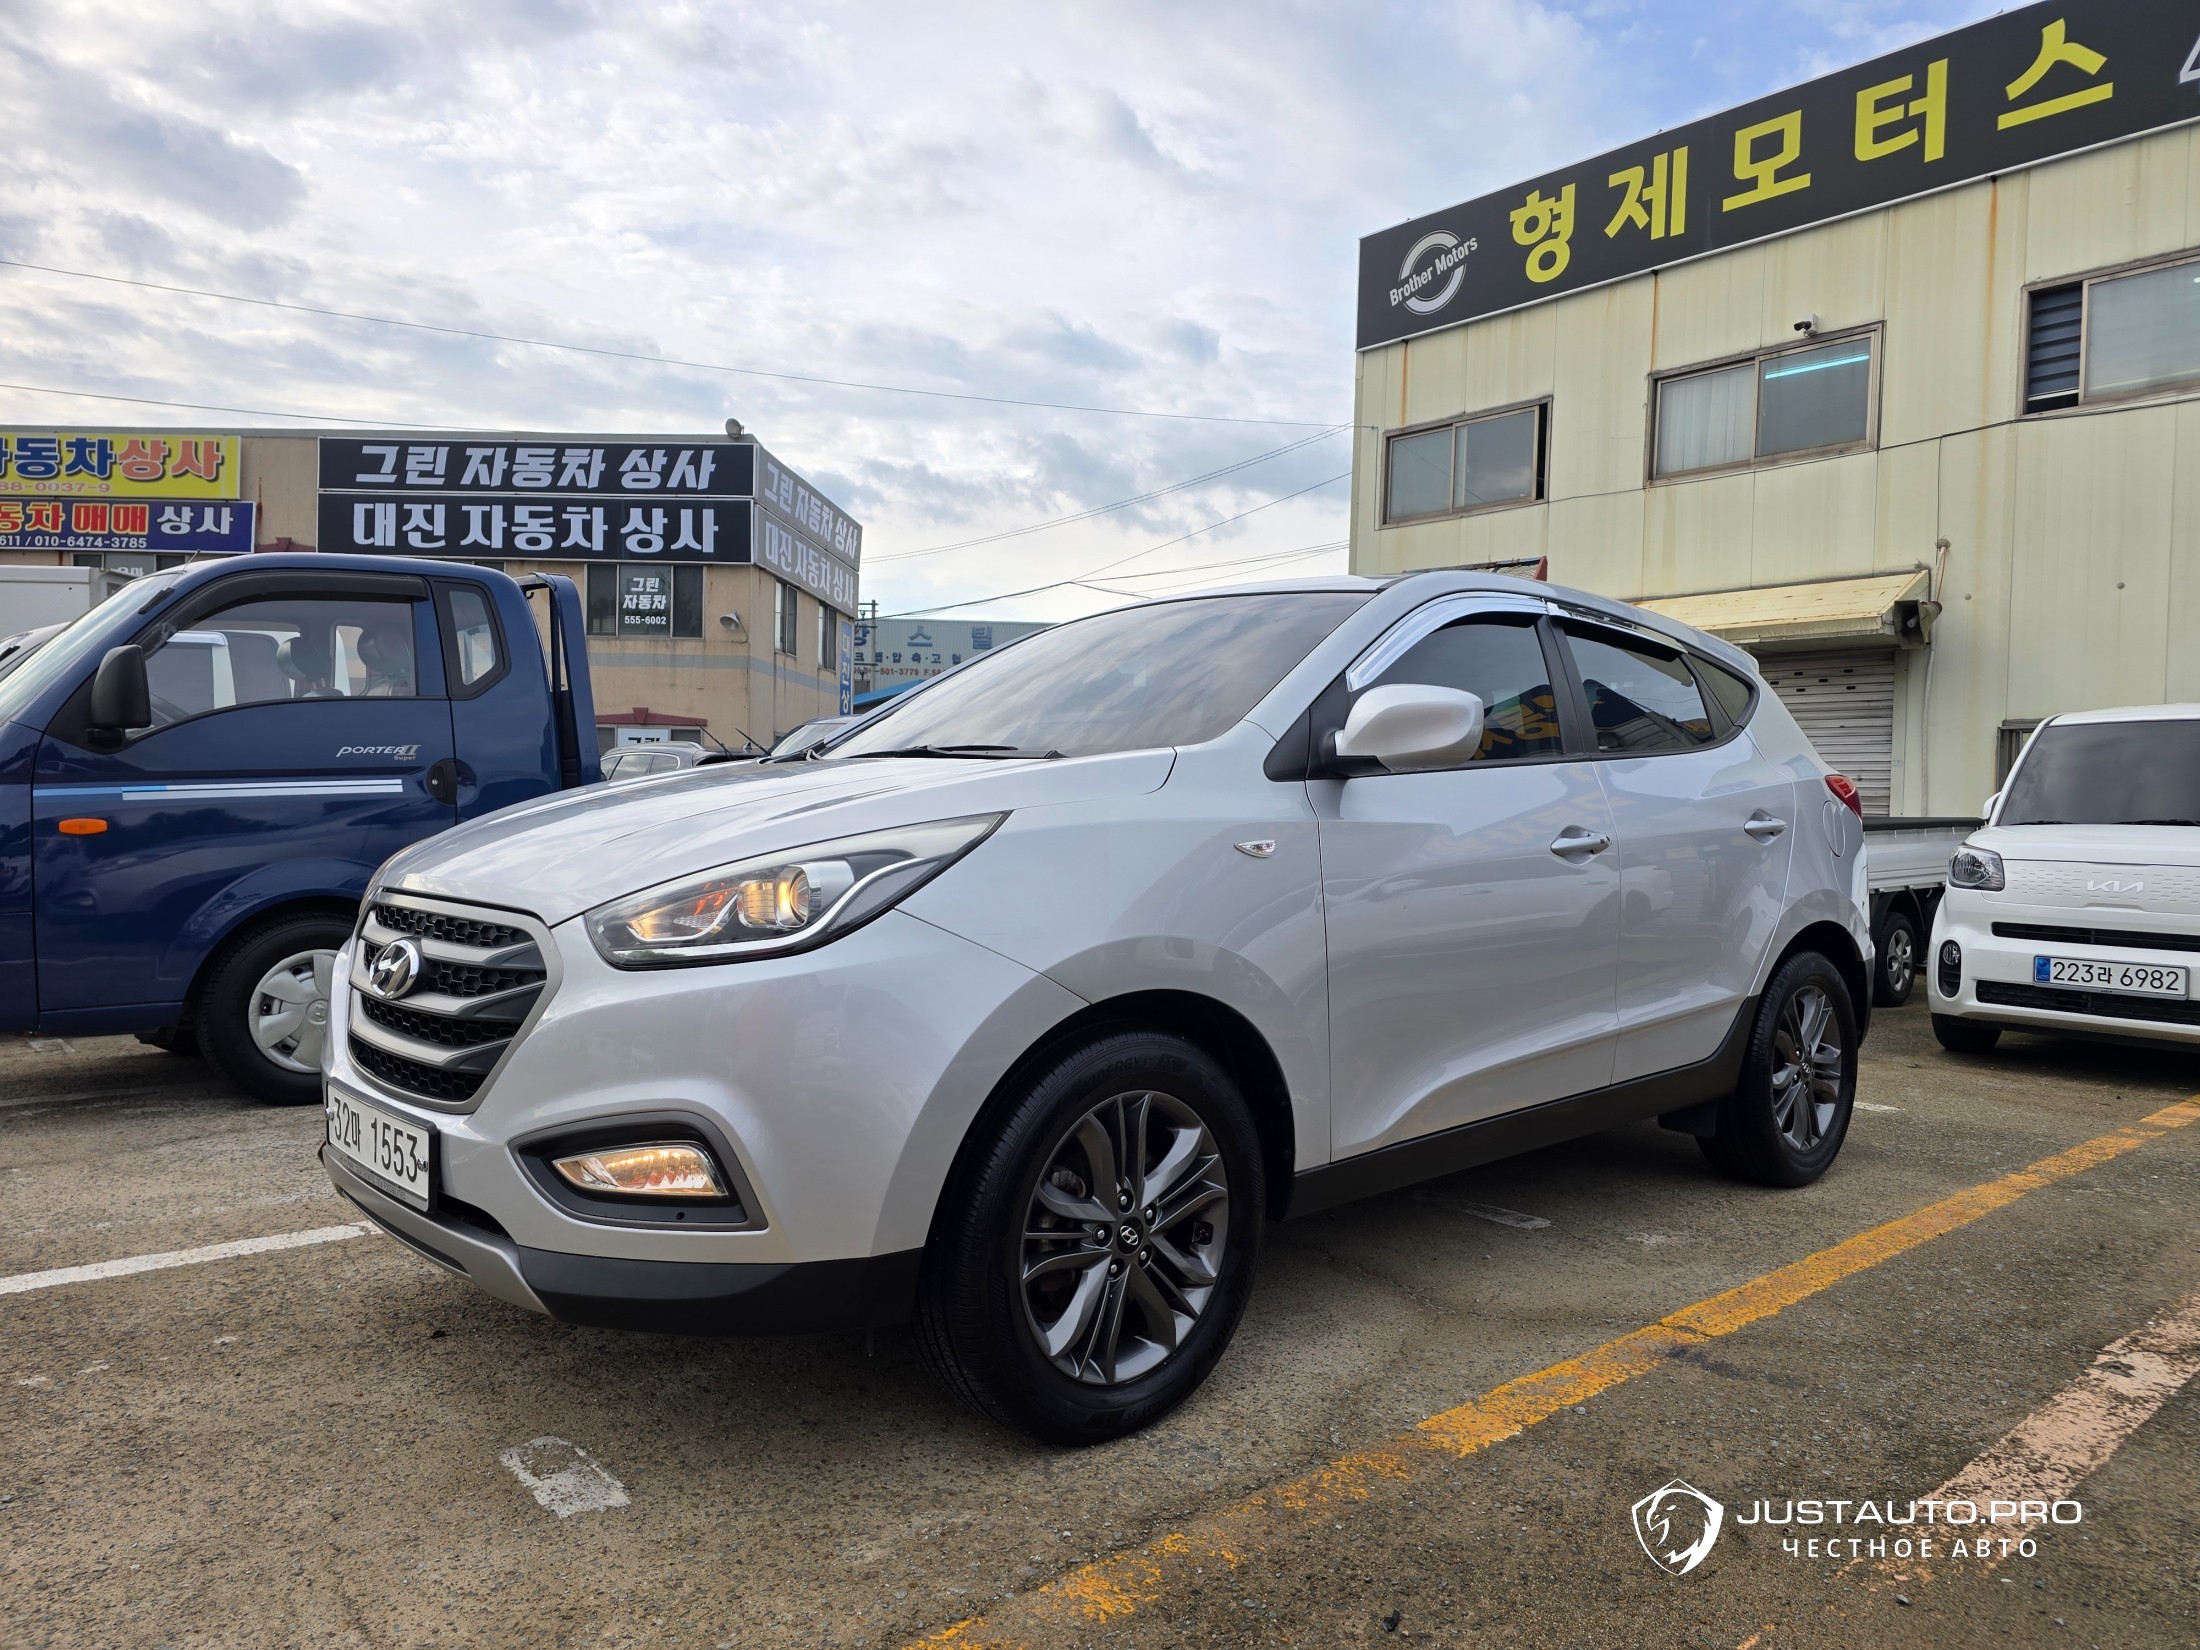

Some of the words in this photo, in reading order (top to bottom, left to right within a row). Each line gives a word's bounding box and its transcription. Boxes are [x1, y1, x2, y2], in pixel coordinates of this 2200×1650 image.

[1510, 18, 2114, 283] 형제모터스
[1389, 266, 1433, 307] Brother
[1434, 237, 1478, 275] Motors
[356, 445, 449, 484] 그린
[460, 447, 606, 490] 자동차
[618, 448, 717, 491] 상사
[71, 502, 149, 535] 매매
[156, 505, 234, 535] 상사
[352, 502, 446, 548] 대진
[460, 504, 608, 551] 자동차
[620, 507, 719, 554] 상사
[764, 461, 793, 514] 그린
[795, 485, 834, 542] 자동차
[834, 516, 858, 559] 상사
[34, 535, 148, 548] 010-6474-3785
[764, 520, 792, 572] 대진
[795, 540, 831, 595] 자동차
[833, 566, 854, 609] 상사
[622, 594, 667, 610] 자동차
[630, 577, 660, 592] 그린
[624, 615, 667, 625] 555-6002
[336, 746, 406, 757] PORTER
[2053, 961, 2113, 984] 223라
[2120, 967, 2179, 991] 6982
[334, 1096, 361, 1153] 32마
[371, 1116, 418, 1183] 1553
